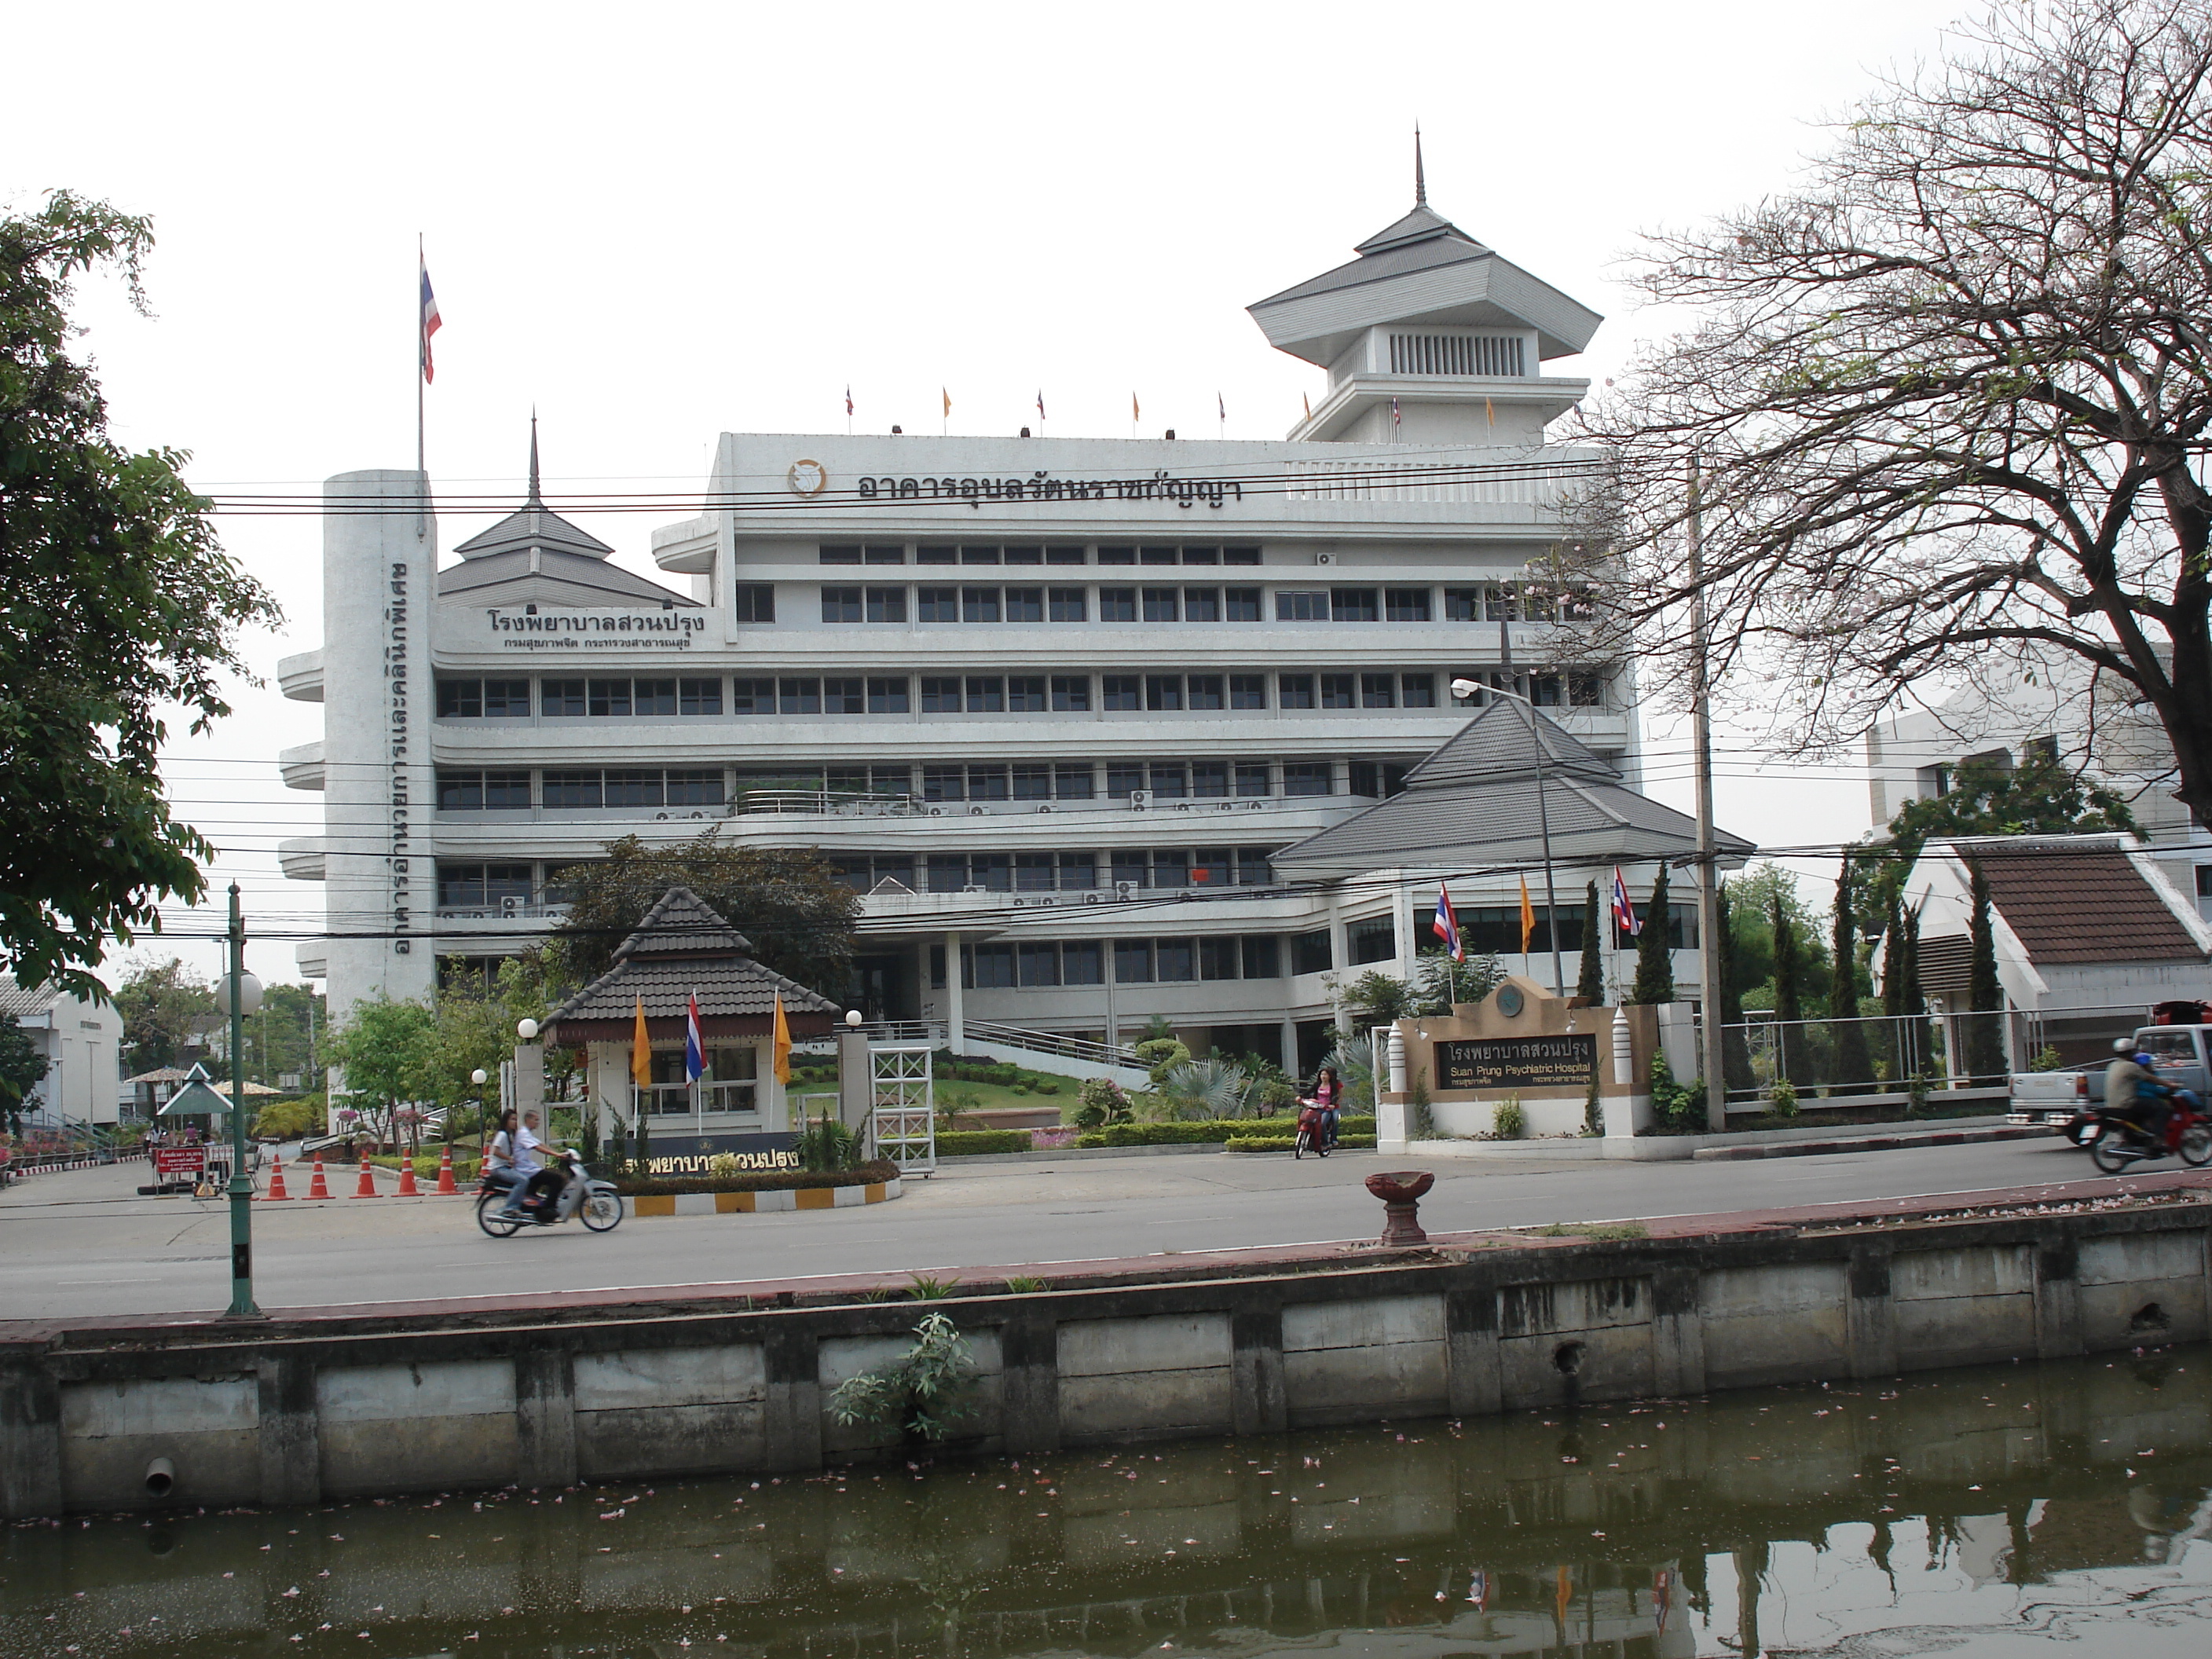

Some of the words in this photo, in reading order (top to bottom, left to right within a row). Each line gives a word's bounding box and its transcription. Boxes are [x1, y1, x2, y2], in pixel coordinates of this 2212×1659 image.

[859, 471, 1242, 508] อาคารอุบลรัตนราชกัญญา
[487, 610, 705, 638] โรงพยาบาลสวนปรุง
[504, 638, 578, 650] กรมสุขภาพจิต
[584, 638, 690, 650] กระทรวงสาธารณสุข
[384, 563, 410, 954] อาคารอำนวยการและคลินิกพิเศษ
[1448, 1038, 1588, 1061] โรงพยาบาลสวนปรุง
[1451, 1067, 1473, 1077] Suan
[1477, 1065, 1502, 1077] Prung
[1505, 1063, 1553, 1076] Psychiatric
[1555, 1062, 1591, 1074] Hospital
